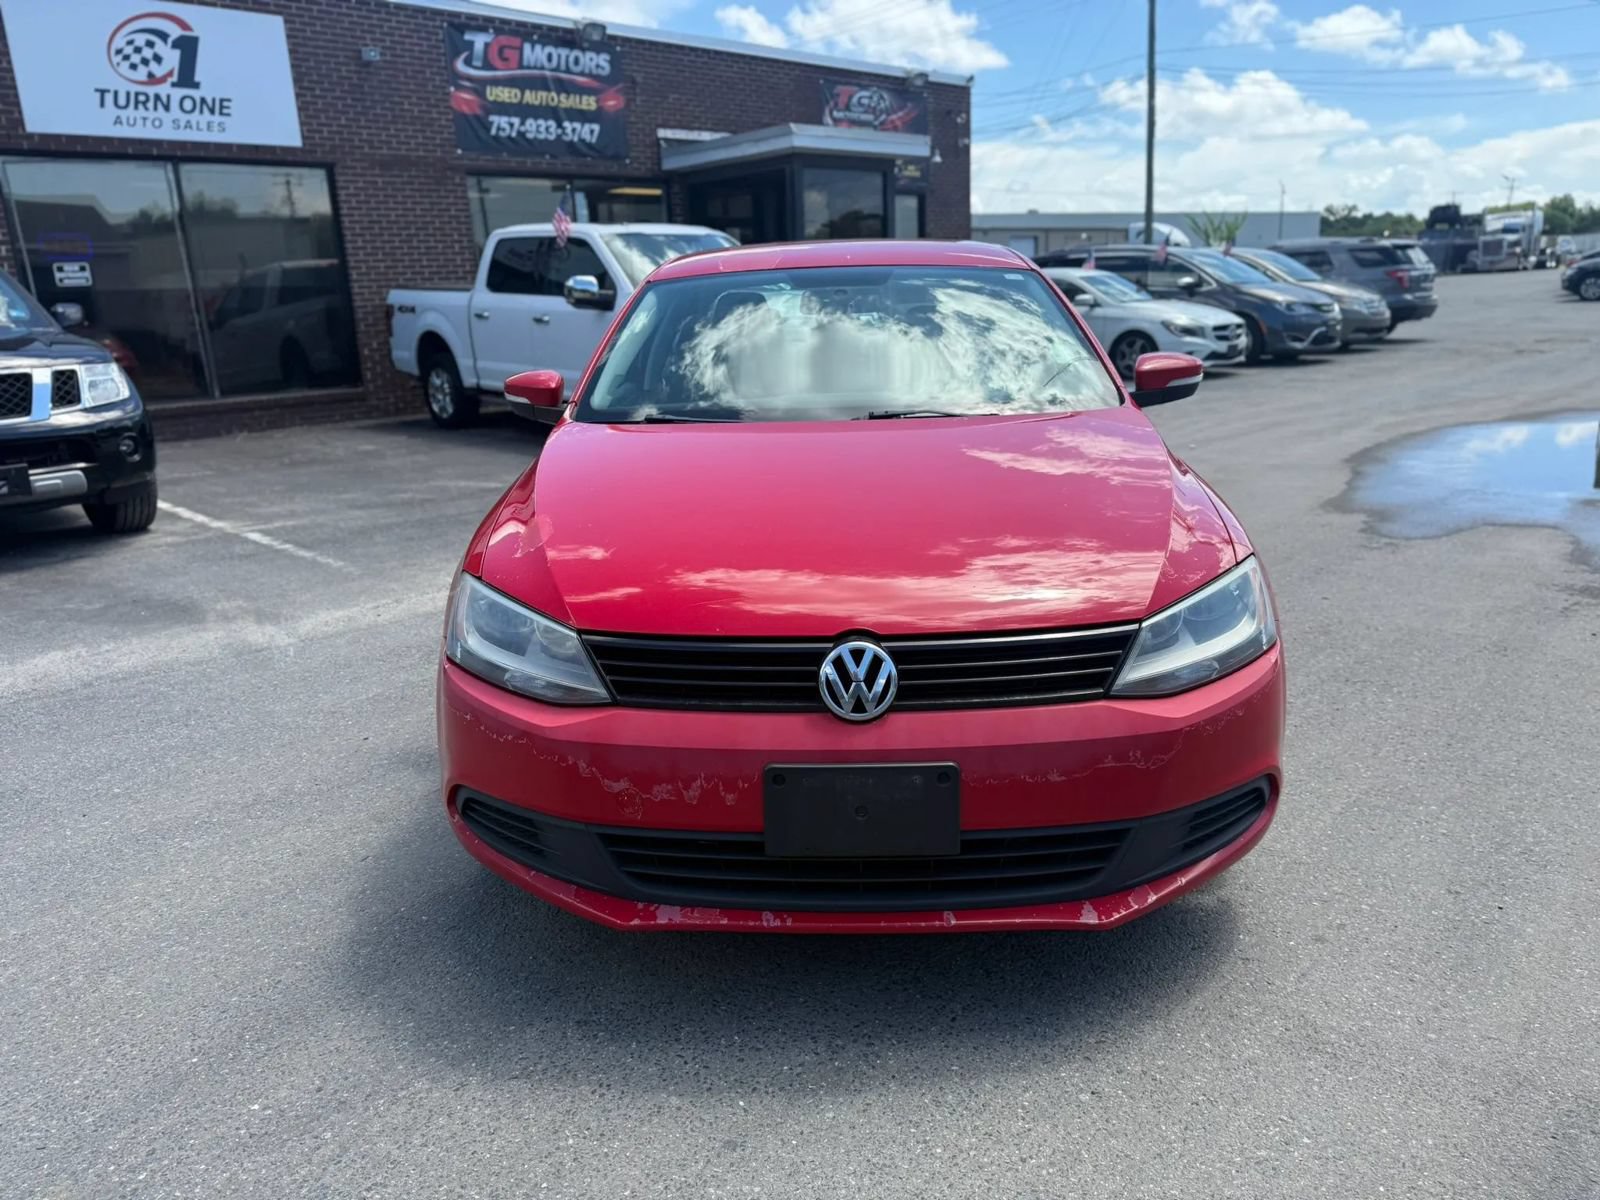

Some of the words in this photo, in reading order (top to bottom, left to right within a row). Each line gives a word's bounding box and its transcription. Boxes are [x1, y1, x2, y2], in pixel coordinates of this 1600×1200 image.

[523, 43, 611, 76] MOTORS
[94, 88, 171, 112] TURN
[179, 96, 232, 117] ONE
[486, 85, 521, 104] USED
[522, 90, 558, 107] AUTO
[558, 94, 598, 111] SALES
[113, 115, 164, 130] AUTO
[172, 119, 227, 133] SALES
[488, 114, 601, 144] 757-933-3747
